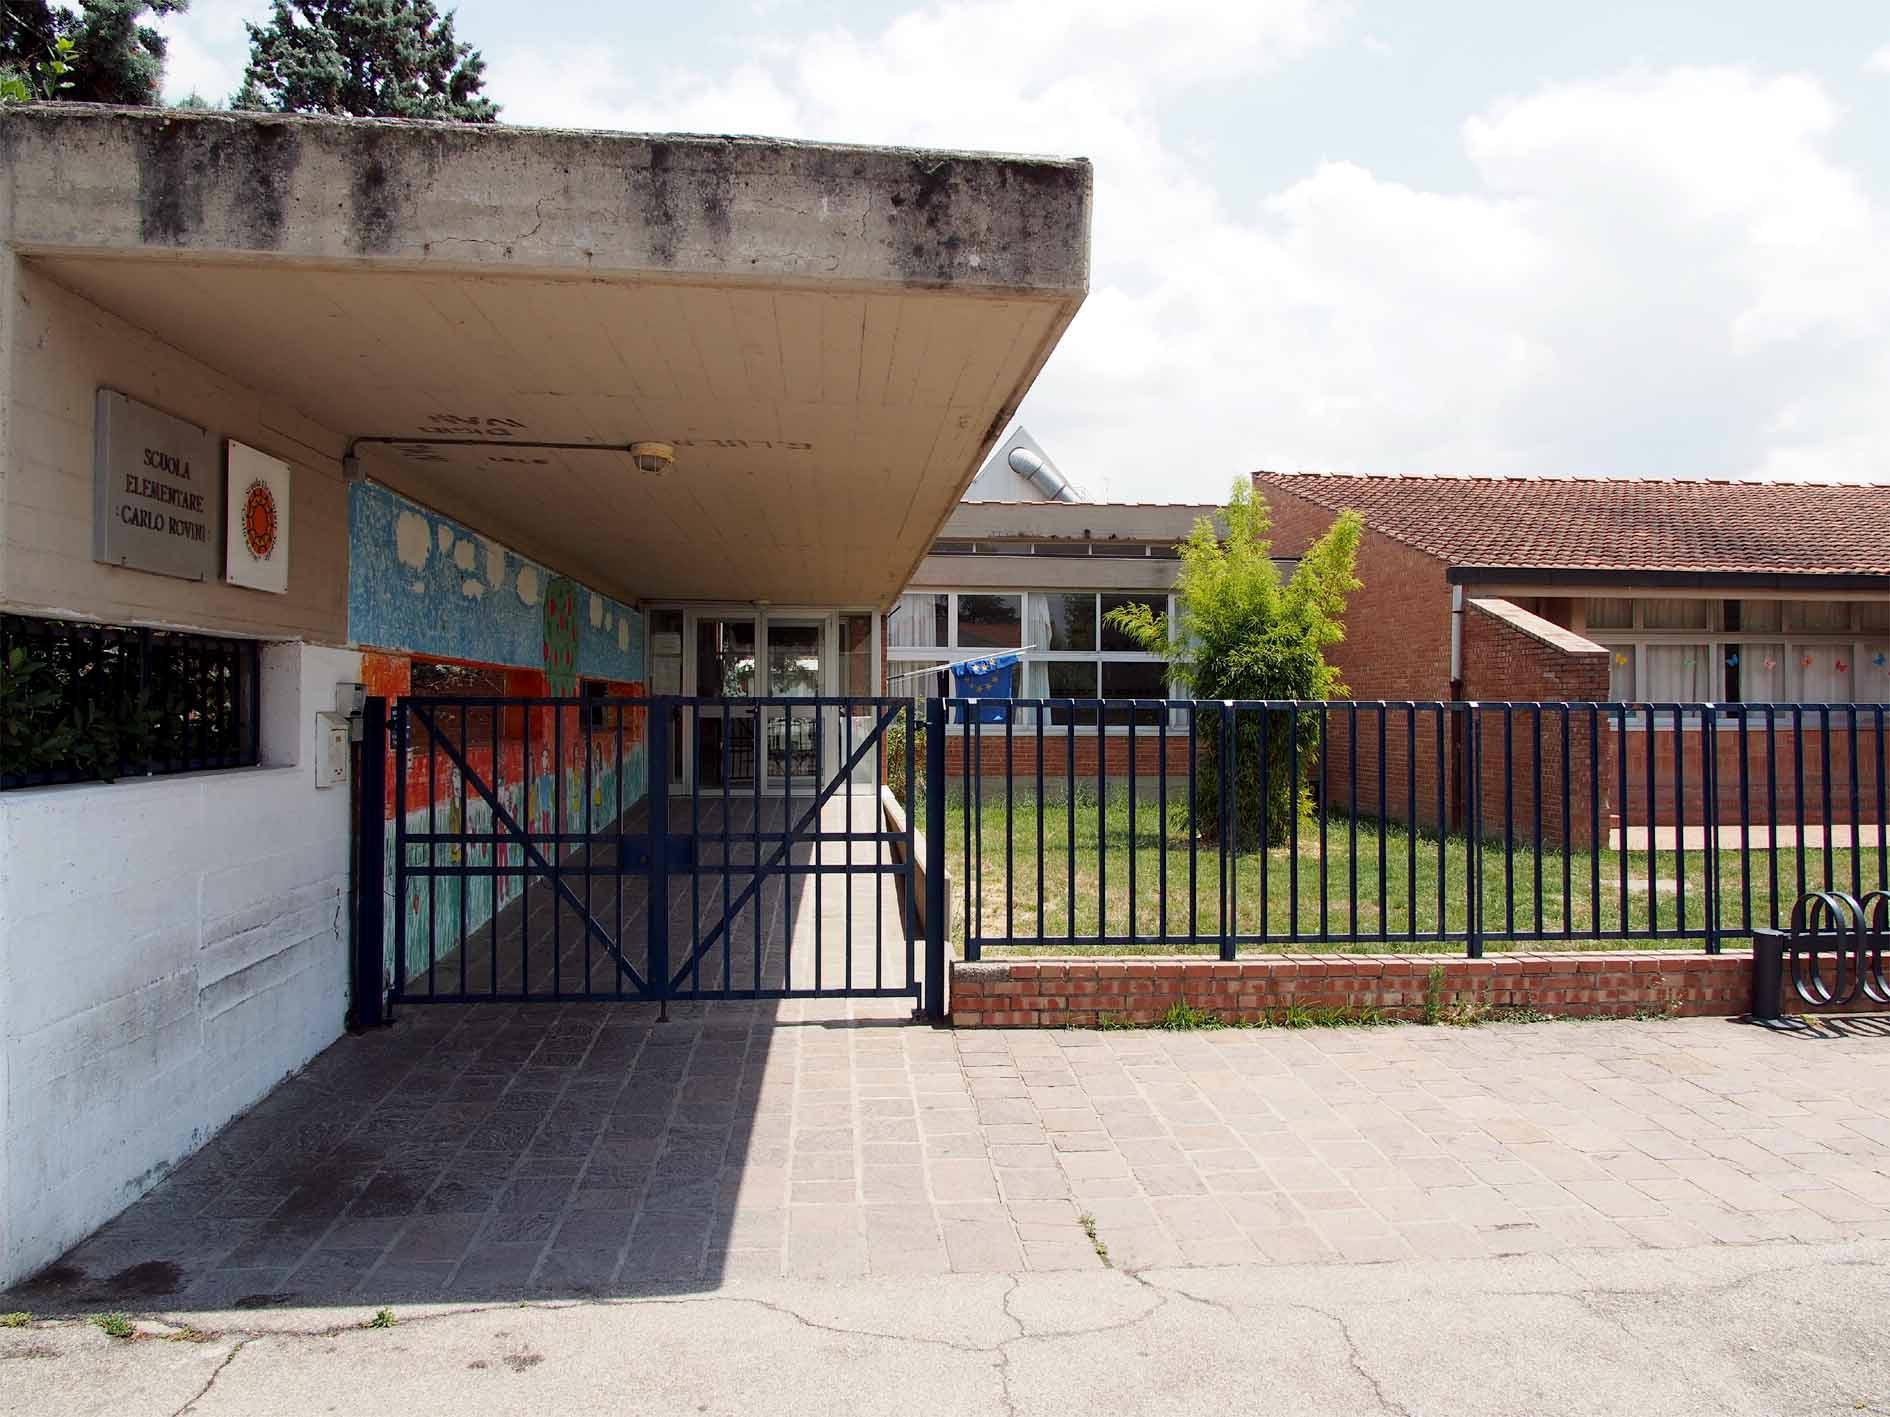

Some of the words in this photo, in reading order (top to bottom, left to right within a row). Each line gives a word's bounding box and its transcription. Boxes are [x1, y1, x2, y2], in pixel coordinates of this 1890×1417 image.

[144, 449, 190, 480] SCUOLA
[126, 474, 204, 513] ELEMENTARE
[121, 505, 164, 532] CARLO
